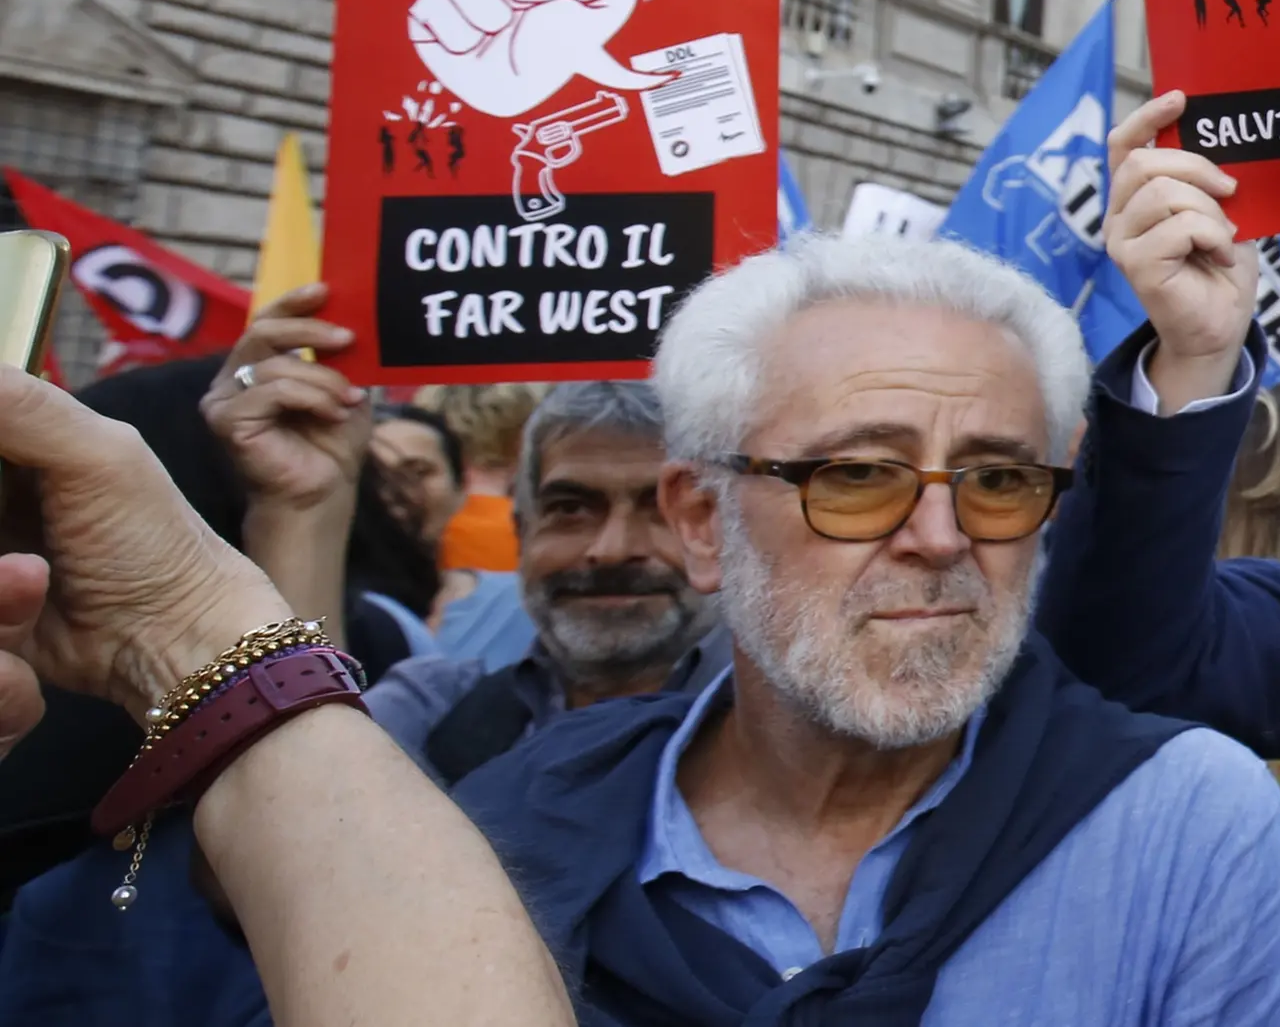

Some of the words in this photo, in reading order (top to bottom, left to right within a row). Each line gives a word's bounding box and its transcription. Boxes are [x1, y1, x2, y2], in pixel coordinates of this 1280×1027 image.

[665, 46, 695, 64] DDL
[405, 224, 608, 272] CONTRO
[621, 223, 675, 269] IL
[421, 290, 524, 339] FAR
[539, 285, 675, 335] WEST
